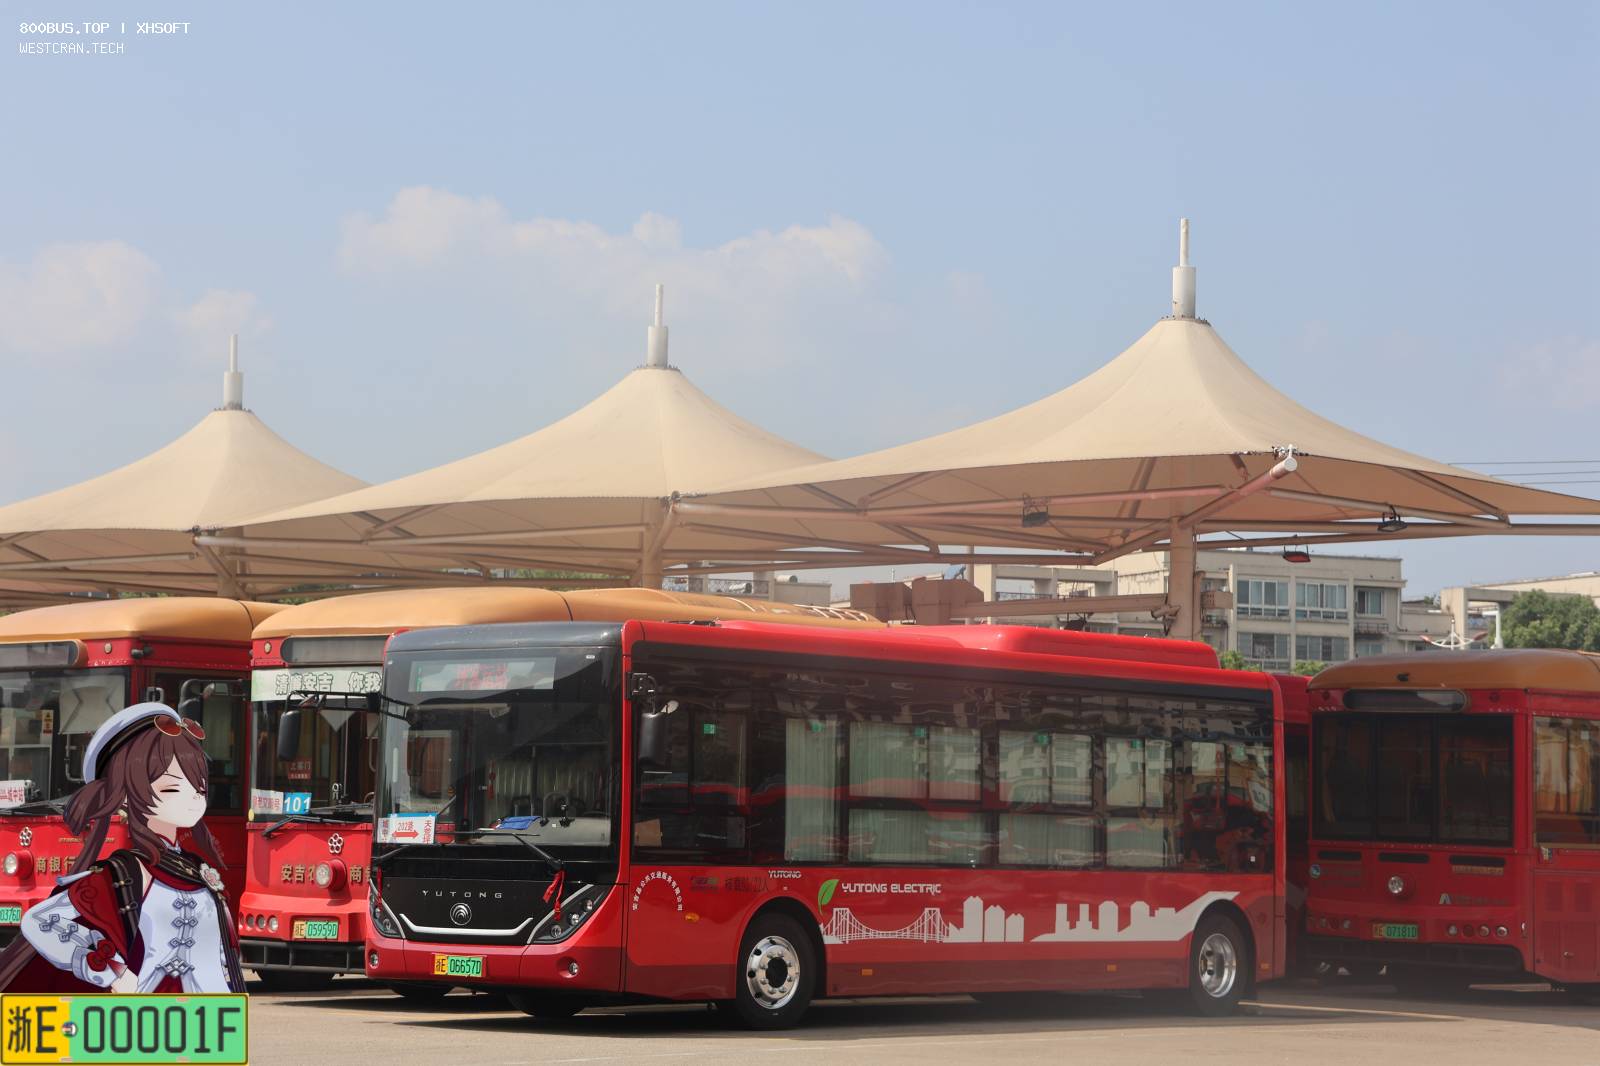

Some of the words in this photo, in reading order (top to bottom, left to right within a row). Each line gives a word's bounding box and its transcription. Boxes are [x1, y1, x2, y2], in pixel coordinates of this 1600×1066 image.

[284, 796, 311, 812] 101
[768, 870, 802, 879] YUTONG
[841, 883, 888, 893] YUTONG
[422, 890, 502, 899] YUTONG
